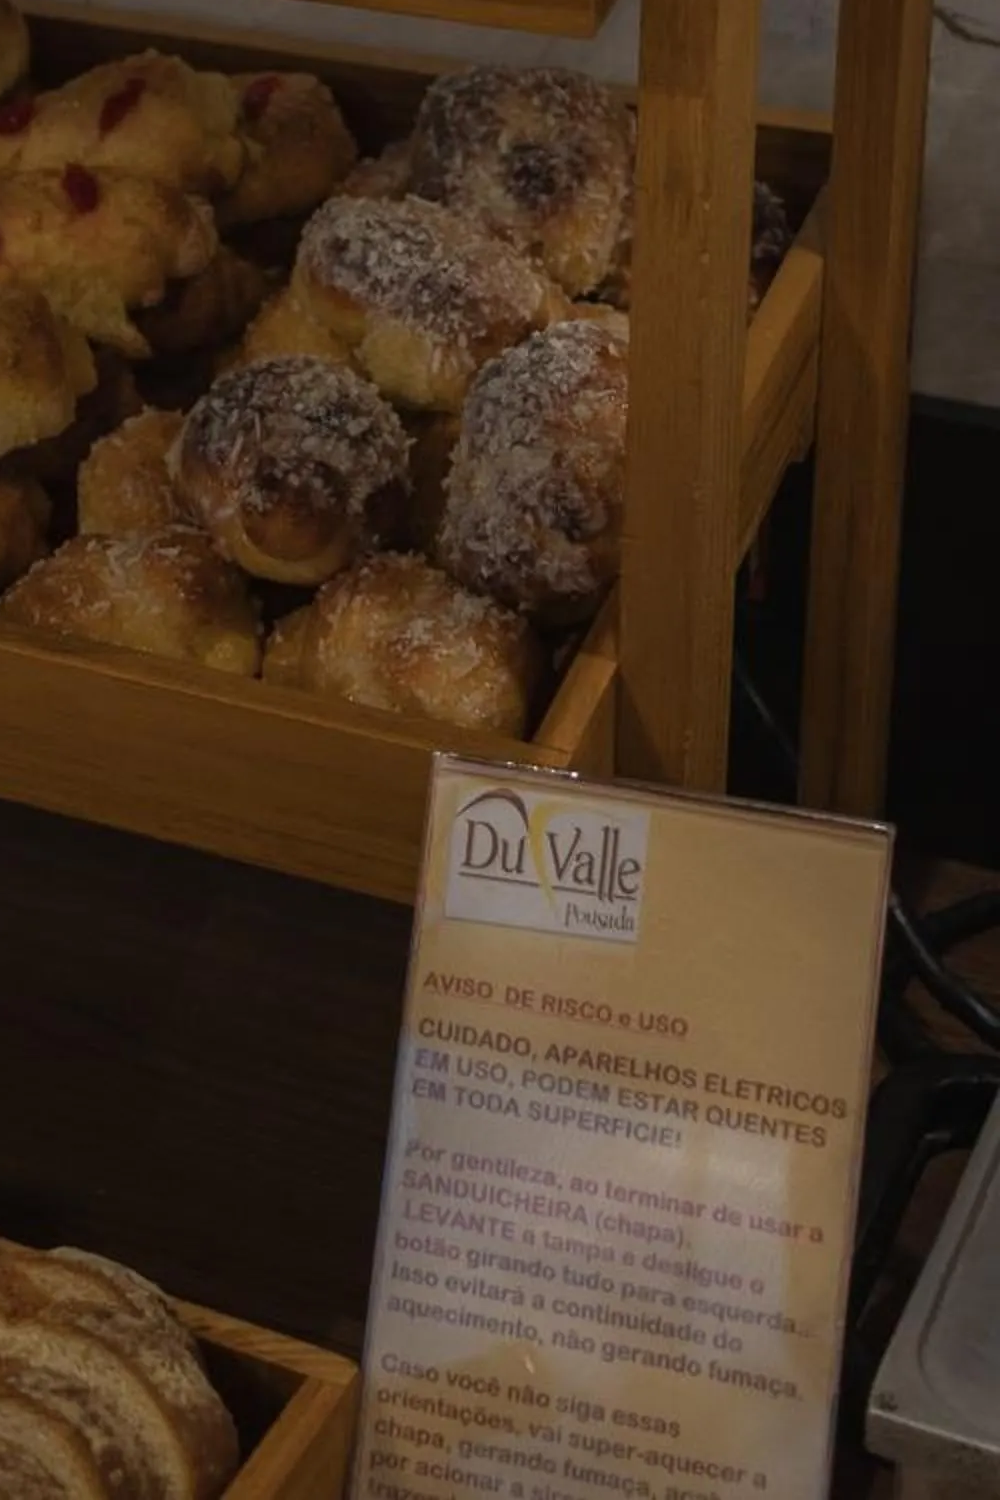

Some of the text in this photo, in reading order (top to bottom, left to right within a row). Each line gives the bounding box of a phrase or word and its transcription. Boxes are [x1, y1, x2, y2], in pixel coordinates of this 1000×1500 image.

[460, 819, 641, 904] Du Valle
[423, 971, 689, 1037] AVISO DE RISCO e USO
[411, 1077, 447, 1102] EM
[453, 1085, 521, 1119] TODA
[414, 1048, 828, 1148] EM USO, PODEM ESTAR QUENTES
[418, 1016, 848, 1120] CUIDADO, APARELHOS ELETRICOS
[401, 1169, 589, 1227] SANDUICHEIRA
[404, 1138, 825, 1245] Por gentileza, ao terminar de usar a
[394, 1230, 460, 1261] botão
[466, 1249, 556, 1281] girando
[561, 1264, 616, 1294] tudo
[620, 1280, 676, 1308] para
[403, 1200, 765, 1296] LEVANTE a tampa e desligue o
[387, 1295, 544, 1346] aquecimento,
[551, 1327, 596, 1355] não
[601, 1340, 701, 1378] gerando
[391, 1259, 743, 1352] Isso evitará a continuidade do
[381, 1353, 681, 1439] Caso você não siga essas
[369, 1450, 410, 1472] por
[414, 1459, 504, 1493] acionar
[509, 1481, 524, 1499] a
[374, 1416, 451, 1455] chapa,
[458, 1438, 557, 1475] gerando
[528, 1420, 562, 1444] vai
[568, 1430, 747, 1484] super-aquecer
[752, 1471, 768, 1491] a
